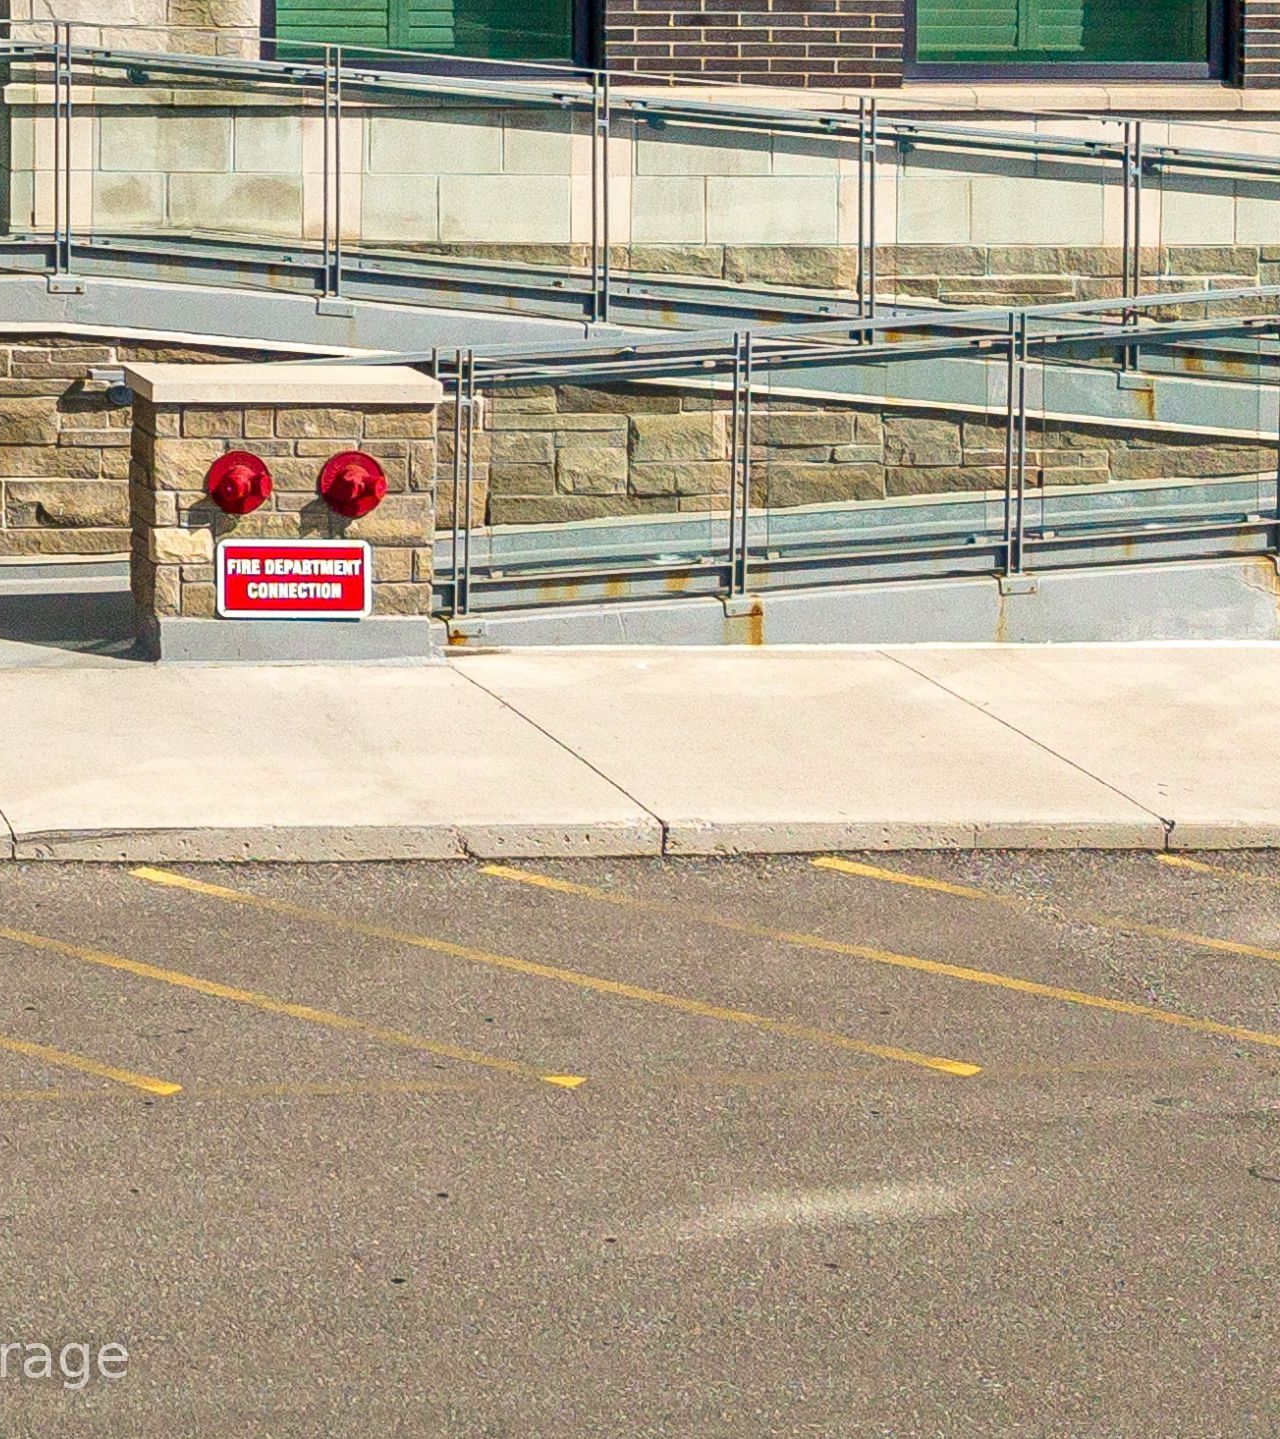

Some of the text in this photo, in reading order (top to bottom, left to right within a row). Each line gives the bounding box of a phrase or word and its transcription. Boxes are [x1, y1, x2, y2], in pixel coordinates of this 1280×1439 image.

[227, 558, 362, 576] FIRE DEPARTMENT
[247, 581, 342, 599] CONNECTION
